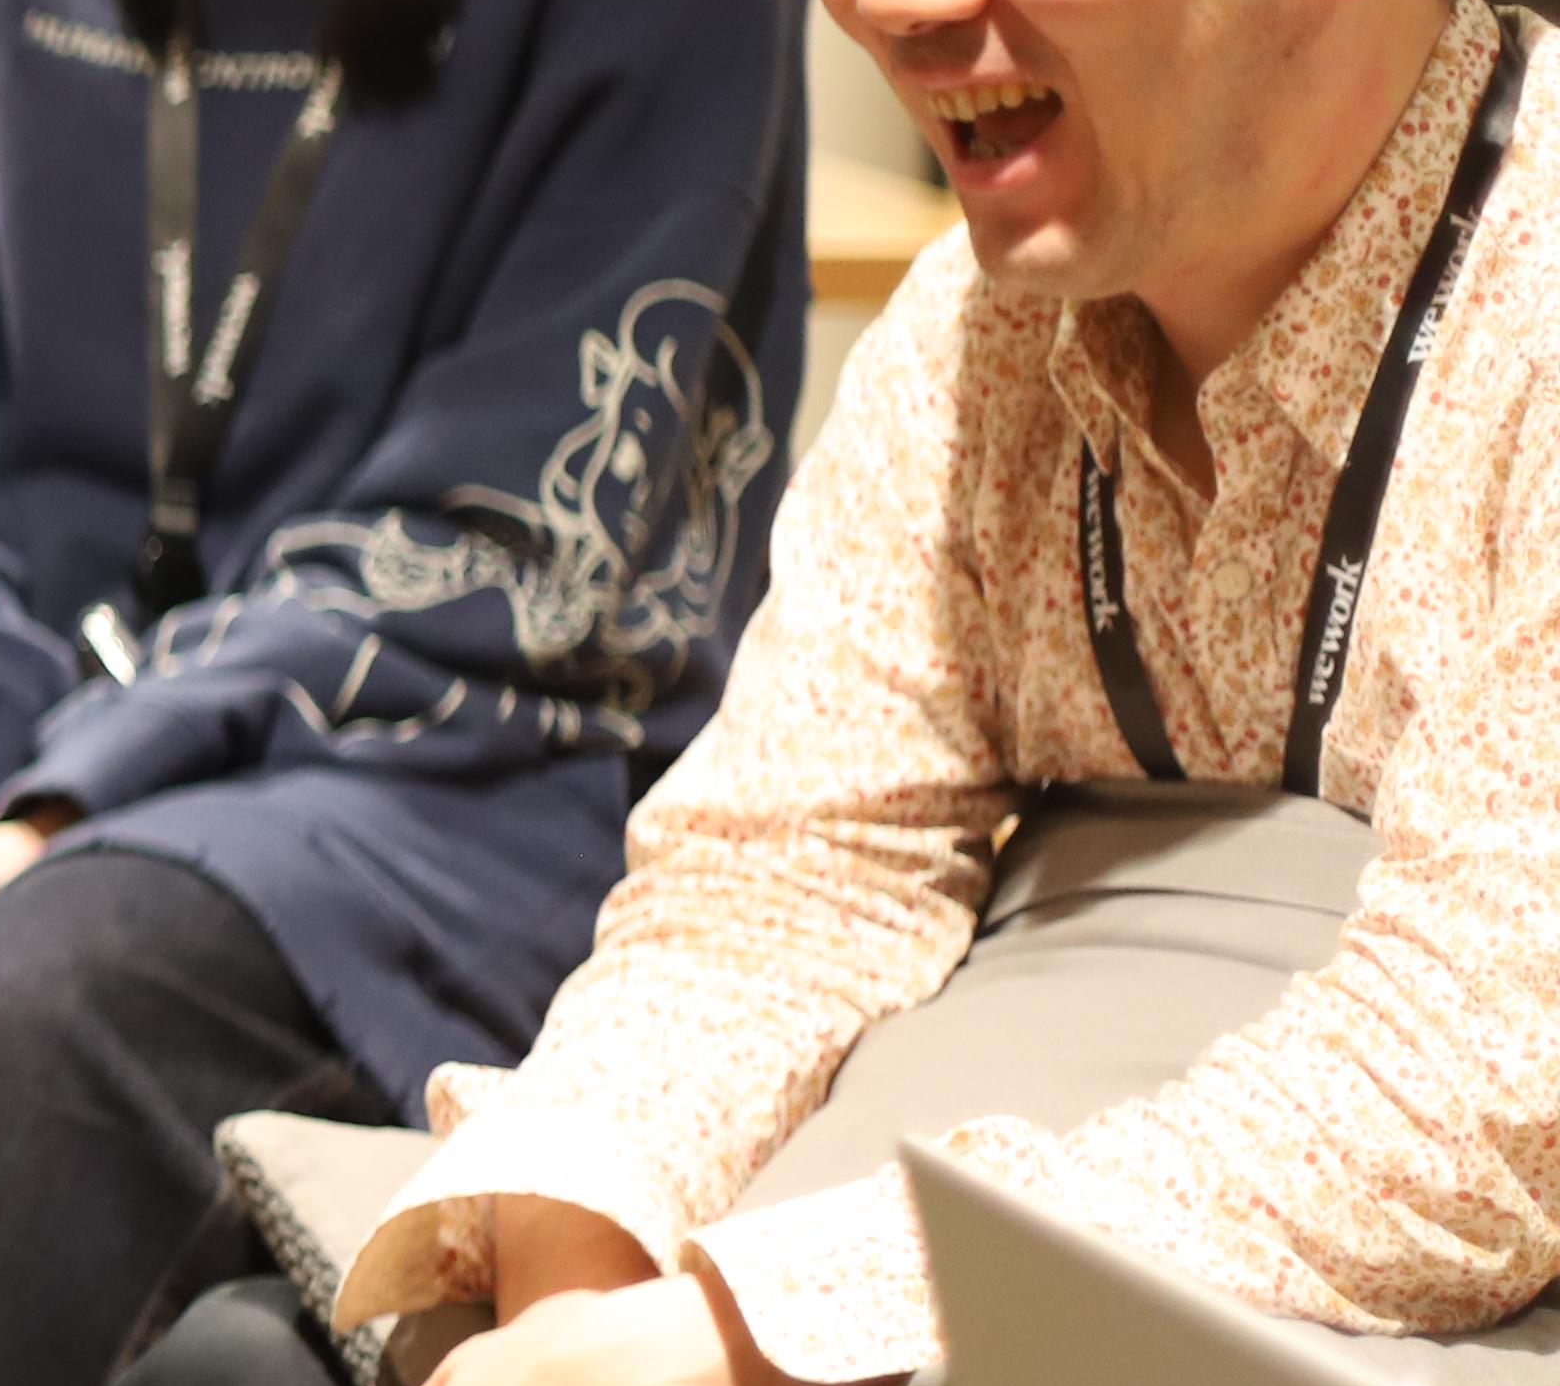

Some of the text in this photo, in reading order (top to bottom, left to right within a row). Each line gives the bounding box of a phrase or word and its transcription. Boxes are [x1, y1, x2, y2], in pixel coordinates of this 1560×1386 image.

[1407, 207, 1480, 365] wework
[1085, 467, 1120, 634] wework
[1308, 553, 1364, 705] wework
